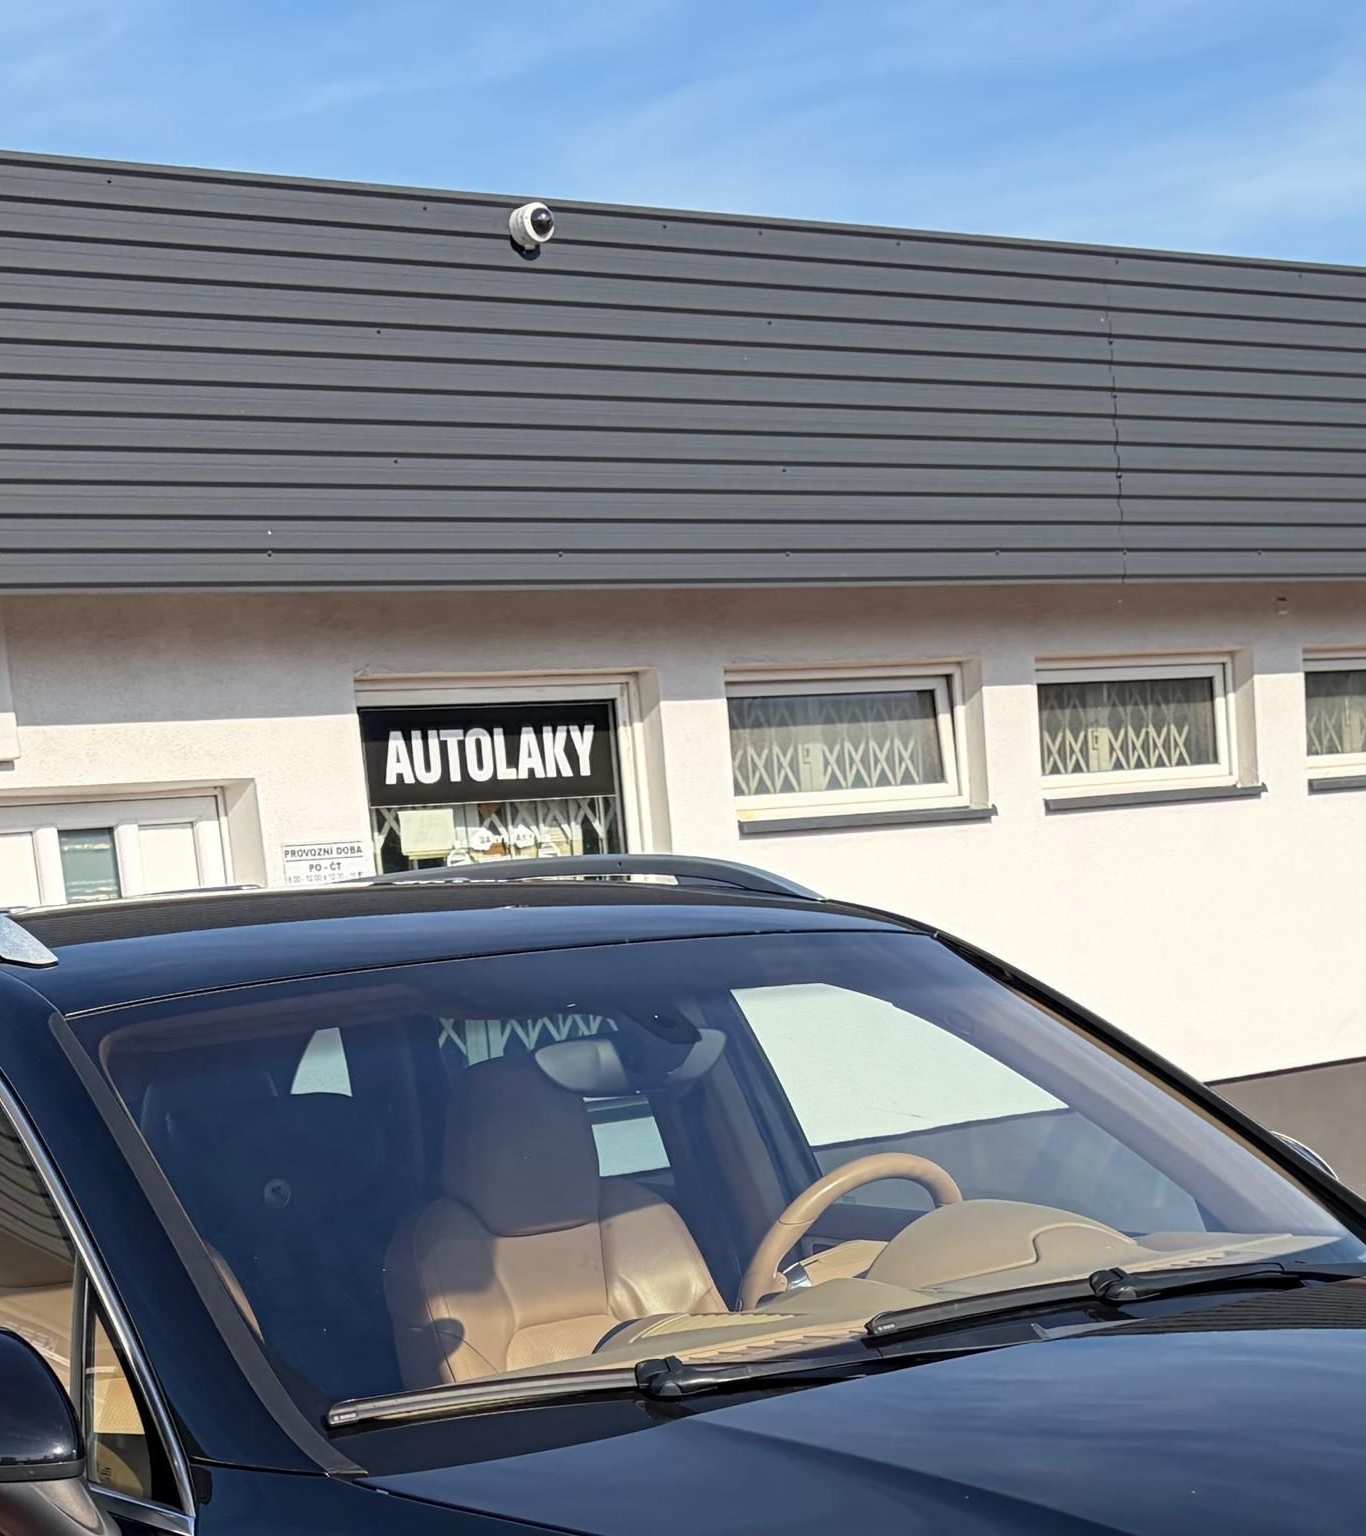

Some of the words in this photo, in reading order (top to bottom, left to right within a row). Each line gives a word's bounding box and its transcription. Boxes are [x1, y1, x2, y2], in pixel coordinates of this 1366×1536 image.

[385, 723, 596, 786] AUTOLAKY
[284, 847, 334, 859] PROVOZNÍ
[335, 845, 364, 855] DOBA
[308, 863, 322, 873] PO
[329, 861, 343, 871] ČT
